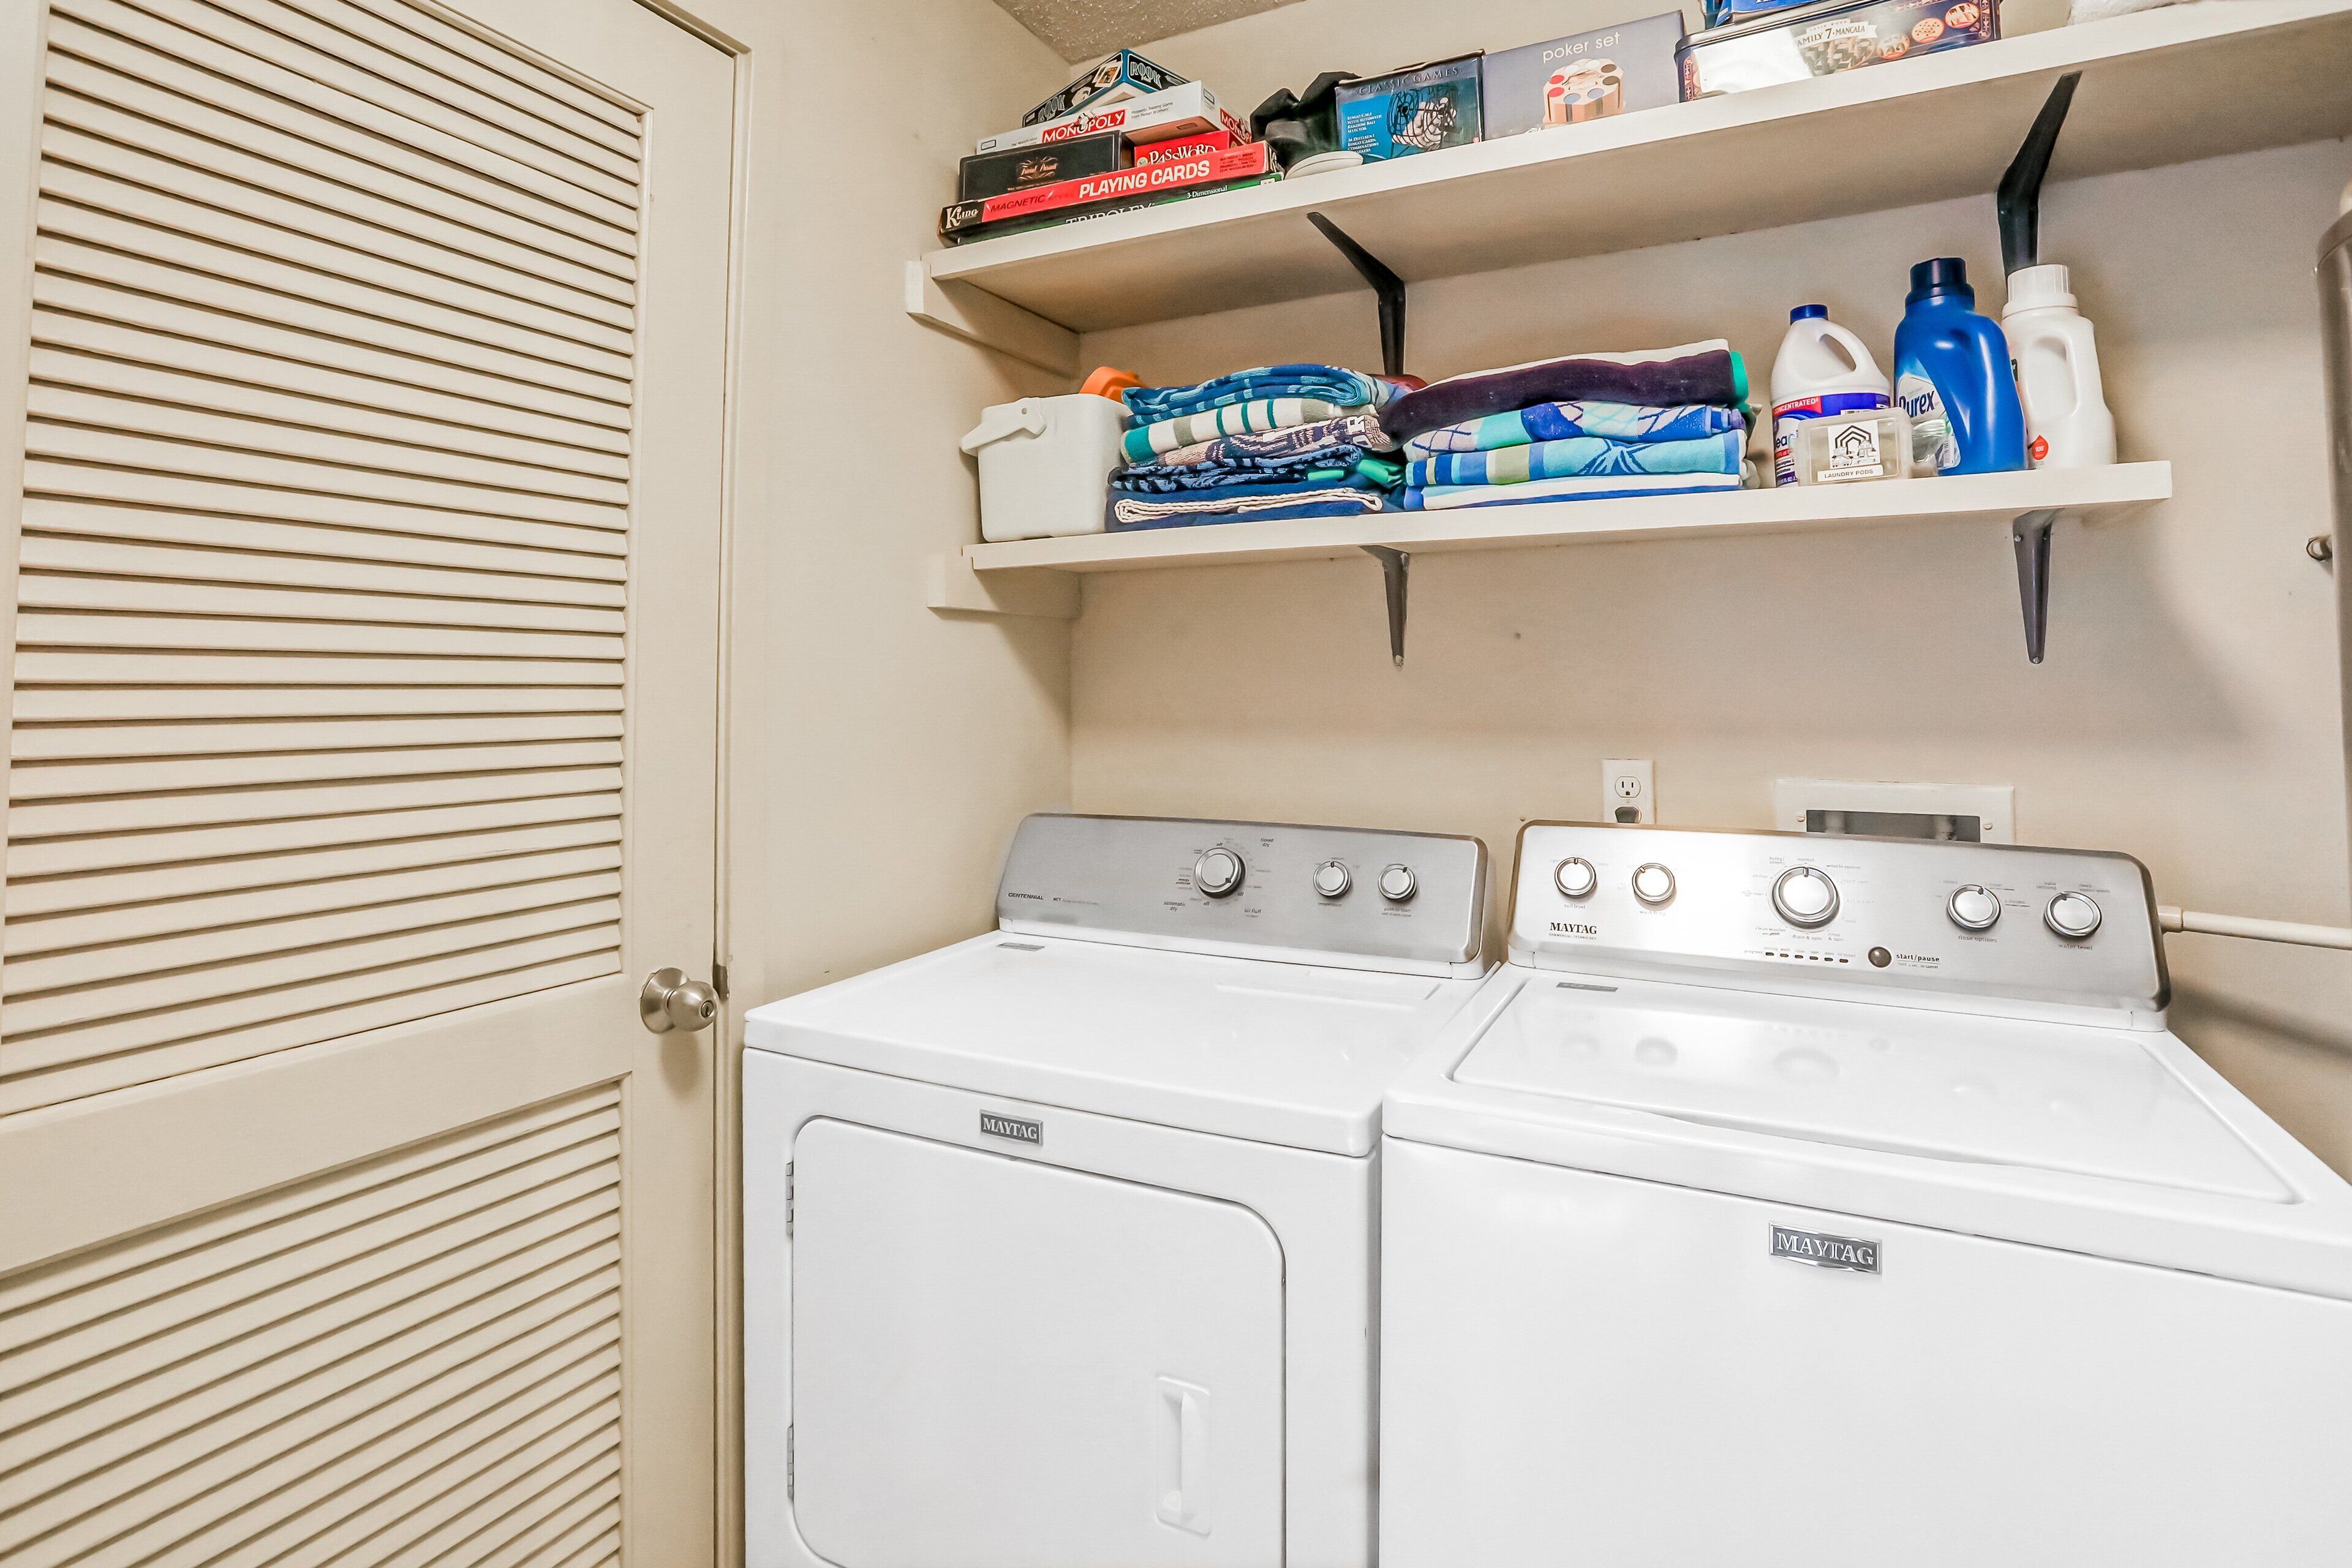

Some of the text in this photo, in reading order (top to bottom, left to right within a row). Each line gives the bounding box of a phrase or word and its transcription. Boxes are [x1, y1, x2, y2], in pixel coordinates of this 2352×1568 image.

[1836, 26, 1865, 36] MANCALA
[1543, 32, 1620, 63] poker set
[1130, 61, 1163, 89] ROOK
[1359, 67, 1458, 96] CLASSIC GAMES
[1043, 111, 1124, 143] MONOPOLY
[990, 195, 1046, 213] MAGNETIC
[1079, 172, 1147, 198] PLAYING
[1151, 160, 1210, 185] CARDS
[1186, 185, 1227, 199] 3-Dimensional
[1550, 922, 1597, 934] MAYTAG
[1896, 954, 1940, 962] start/pause
[983, 1117, 1037, 1139] MAYTAG
[1777, 1232, 1874, 1265] MAYTAG
